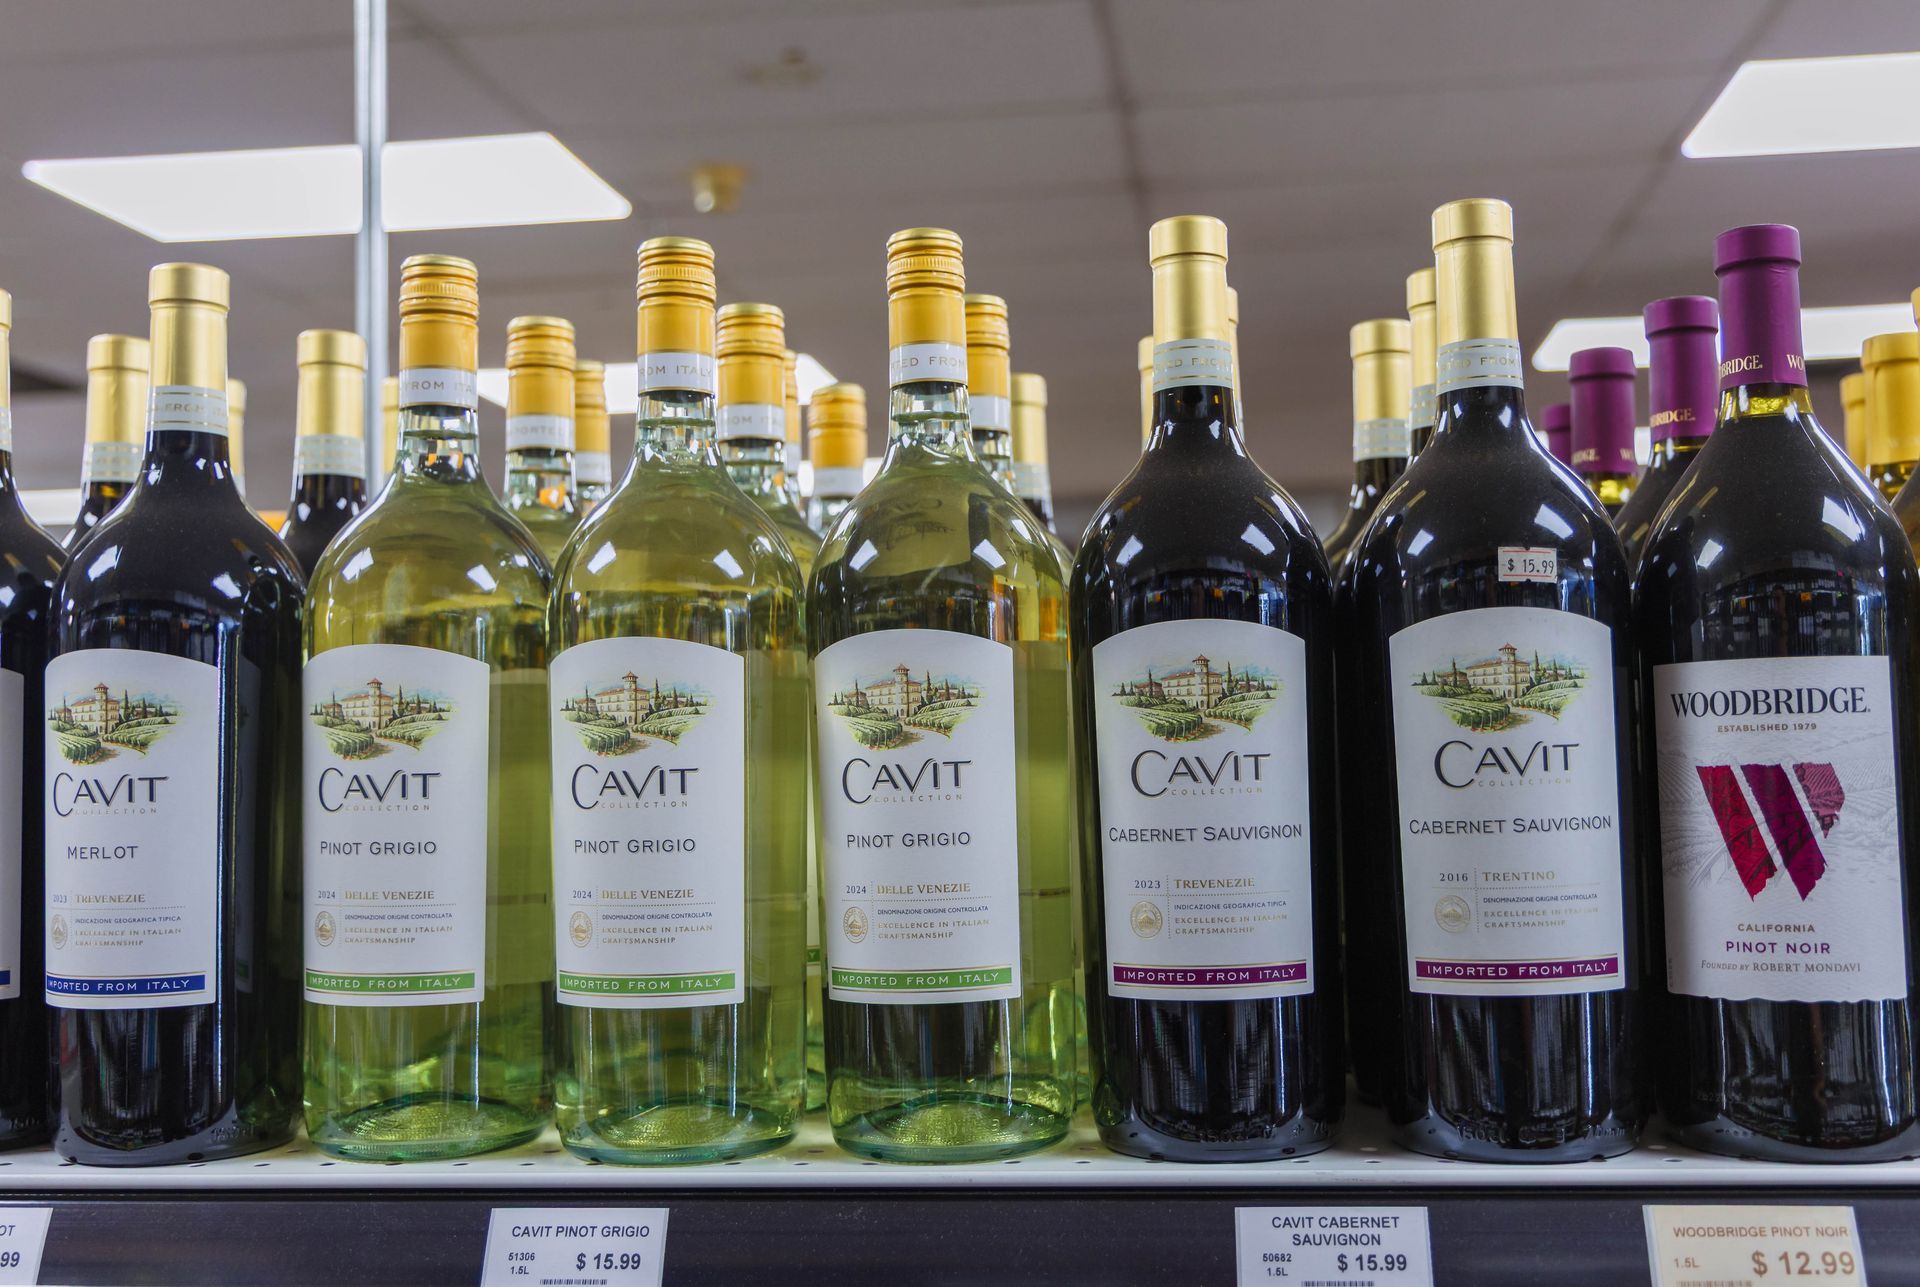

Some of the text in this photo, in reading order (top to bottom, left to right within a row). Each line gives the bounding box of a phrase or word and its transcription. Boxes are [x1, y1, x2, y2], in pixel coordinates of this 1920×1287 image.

[676, 365, 712, 377] ITALY
[1507, 558, 1555, 574] $ 15.99
[1717, 722, 1817, 733] ESTABLISHED 1979
[1434, 740, 1580, 789] CAVIT
[1130, 750, 1271, 798] CAVIT
[571, 763, 700, 810] CAVIT
[842, 758, 974, 805] CAVIT
[53, 772, 170, 817] CAVIT
[318, 767, 442, 812] CAVIT
[1171, 787, 1263, 796] COLLECTION
[601, 800, 688, 809] COLLECTION
[874, 794, 963, 803] COLLECTION
[1409, 815, 1612, 835] CABERNET SAUVIGNON
[1109, 823, 1302, 843] CABERNET SAUVIGNON
[846, 831, 971, 848] PINOT GRIGIO
[320, 841, 437, 855] PINOT GRIGIO
[574, 838, 696, 854] PINOT GRIGIO
[67, 846, 139, 859] MERLOT
[1439, 871, 1556, 882] 2016 TRENTINO
[846, 883, 971, 895] 2024 DELLE VENEZIE
[1134, 878, 1255, 889] 2023 TREVENEZIE
[75, 894, 146, 903] TREVENEZIE
[318, 891, 435, 900] 2024 DELLE VENEZIE
[572, 889, 695, 899] 2024 DELLE VENEZIE
[1483, 896, 1534, 904] DENOMINAZIONE
[1560, 893, 1598, 901] CONTROLLATA
[1223, 901, 1266, 909] GEOGRAFICA
[1484, 909, 1547, 917] EXCELLENCE
[1175, 916, 1236, 924] EXCELLENCE
[1737, 923, 1816, 933] CALIFORNIA
[1726, 941, 1831, 954] PINOT NOIR
[1427, 962, 1608, 976] IMPORTED FROM ITALY
[1753, 963, 1800, 972] ROBERT
[1804, 963, 1861, 973] MONDAVI
[838, 973, 999, 985] IMPORTED FROM ITALY
[1123, 968, 1296, 982] IMPORTED FROM ITALY
[49, 979, 190, 991] PORTED FROM ITALY
[309, 977, 461, 988] IMPORTED FROM ITALY
[564, 978, 722, 990] IMPORTED FROM ITALY
[1272, 1216, 1399, 1228] CAVIT CABERNET
[512, 1226, 650, 1237] CAVIT PINOT GRIGIO
[1673, 1226, 1848, 1237] WOODBRIDGE PINOT NOIR
[1292, 1234, 1381, 1246] SAUVIGNON
[508, 1252, 535, 1261] 51306
[576, 1252, 641, 1271] $ 15.99
[1263, 1253, 1292, 1262] 50682
[1337, 1253, 1407, 1272] $ 15.99
[1673, 1257, 1700, 1268] 1.5L
[1751, 1250, 1855, 1277] $ 12.99
[510, 1266, 529, 1275] 1.5L
[1267, 1267, 1288, 1276] 1.5L
